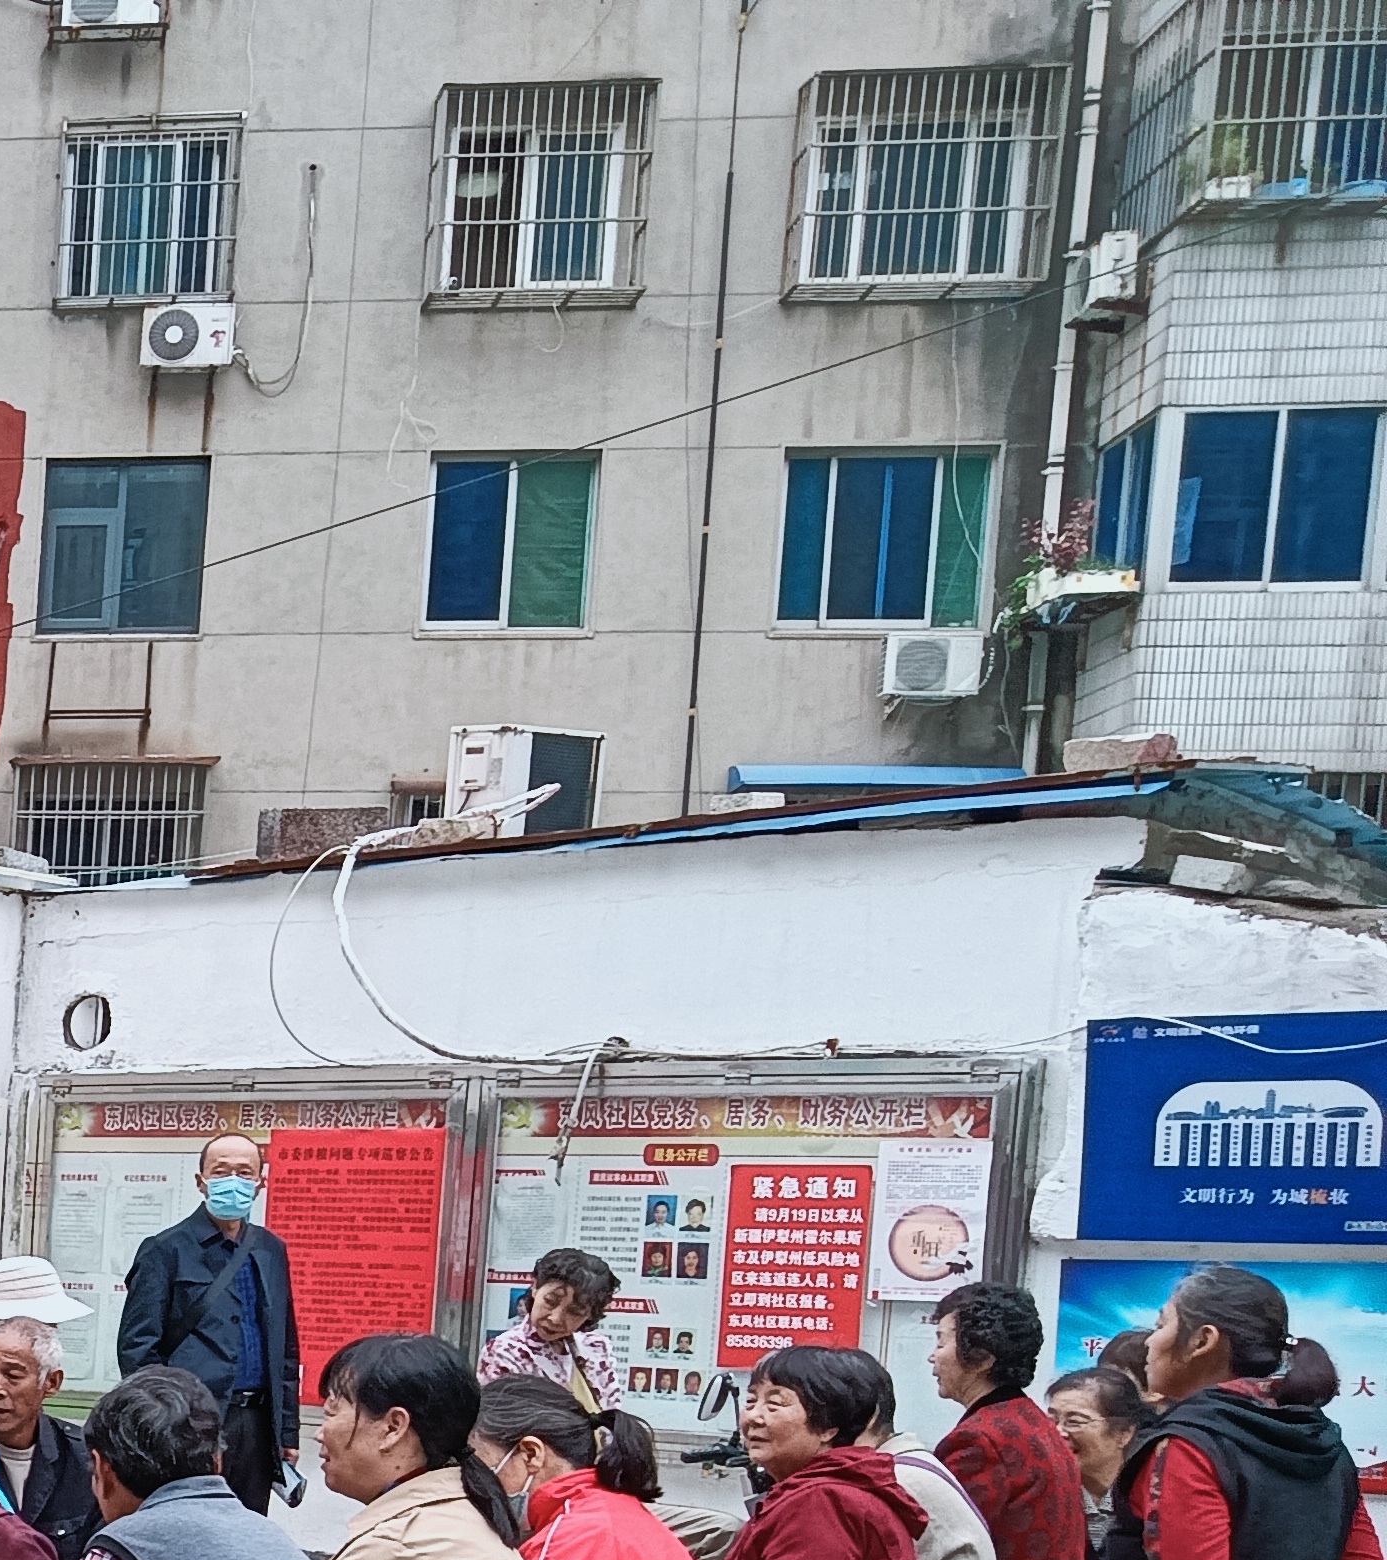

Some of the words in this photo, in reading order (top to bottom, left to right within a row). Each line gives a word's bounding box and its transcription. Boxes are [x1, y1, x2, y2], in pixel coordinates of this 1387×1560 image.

[752, 1176, 857, 1199] 紧急通知
[1179, 1187, 1255, 1205] 文明行为
[754, 1207, 863, 1223] 请9月19日以来从
